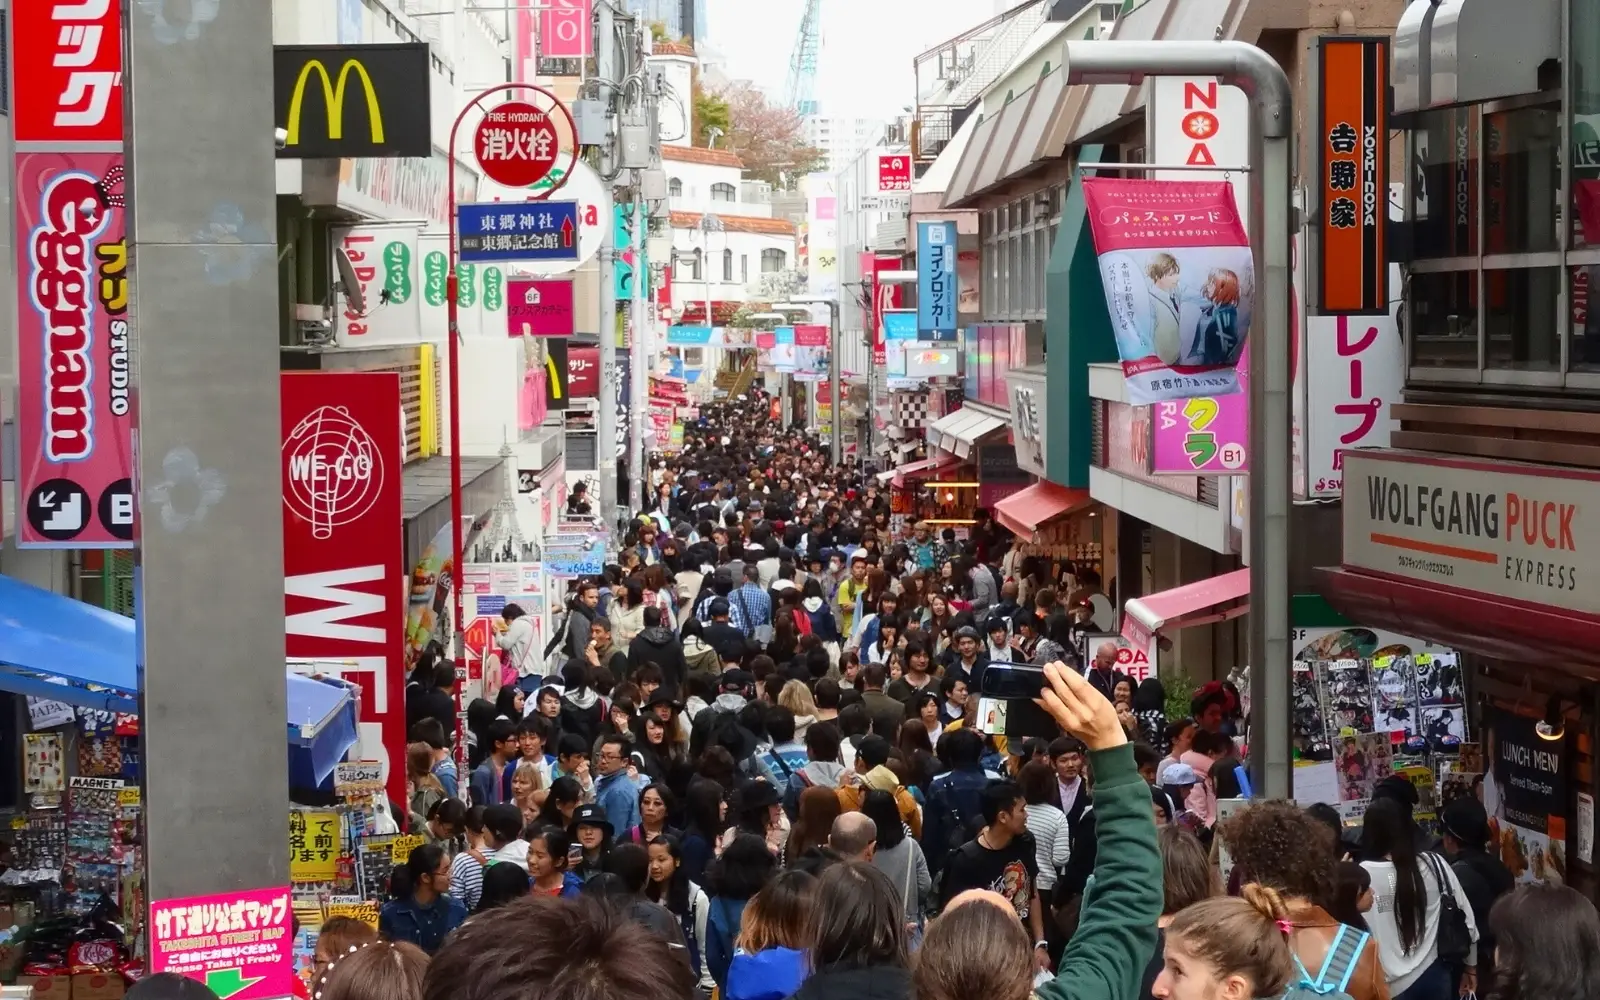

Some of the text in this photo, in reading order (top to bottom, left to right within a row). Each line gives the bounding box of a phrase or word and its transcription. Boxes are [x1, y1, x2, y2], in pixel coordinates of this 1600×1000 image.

[488, 113, 544, 123] FIRE HYDRANT
[1181, 82, 1219, 166] NOA
[482, 128, 552, 161] 消火栓
[480, 212, 555, 232] 東郷神社
[481, 233, 559, 252] 東郷記念館
[931, 246, 943, 327] コインロッカー
[110, 320, 129, 416] STUDIO
[1224, 449, 1242, 462] B1
[1367, 475, 1577, 552] WOLFGANG PUCK
[1505, 556, 1576, 591] EXPRESS
[1501, 741, 1531, 768] LUNCH
[72, 777, 117, 790] MAGNET
[155, 893, 288, 939] 竹下通り公式マップ
[219, 929, 262, 946] STREET
[262, 926, 286, 941] MAP
[205, 958, 234, 970] Take
[247, 952, 282, 968] Freely
